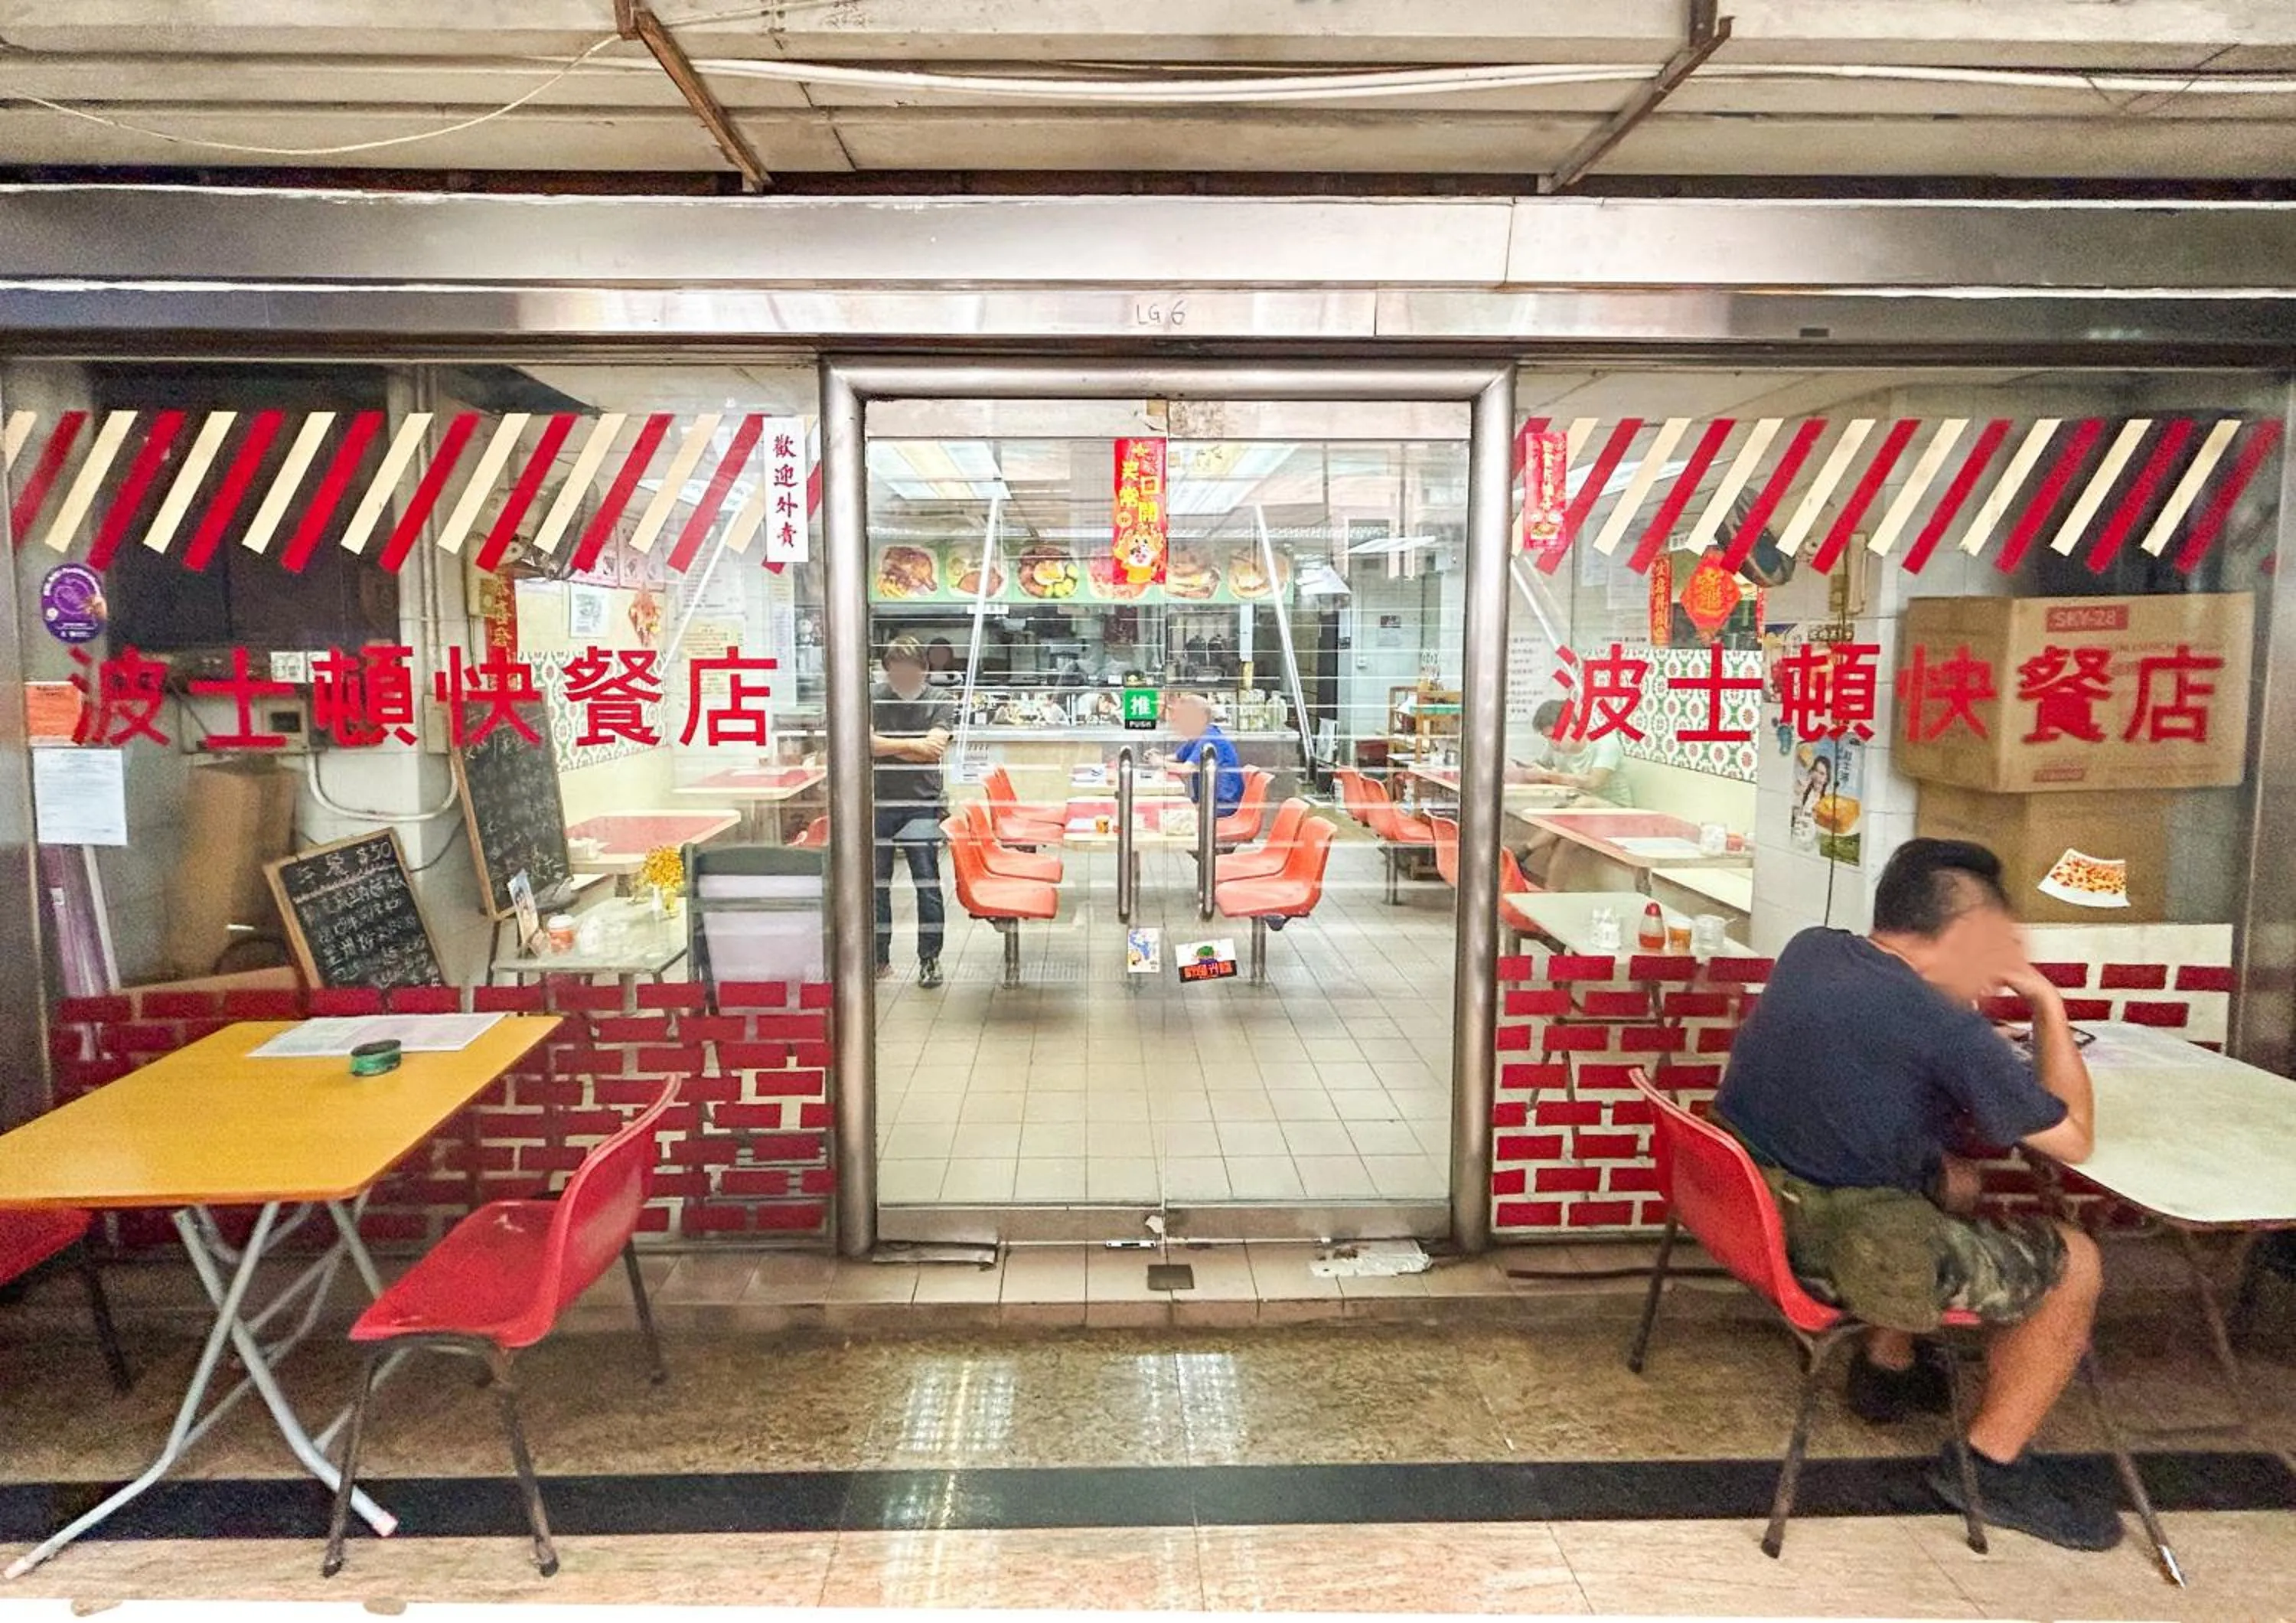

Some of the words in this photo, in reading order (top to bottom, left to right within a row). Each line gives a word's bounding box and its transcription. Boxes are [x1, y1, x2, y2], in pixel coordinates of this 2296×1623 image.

[1137, 303, 1160, 325] LG
[1170, 299, 1186, 325] 6
[2054, 609, 2117, 628] SKY-28
[67, 645, 777, 748] 波士頓快餐店
[1130, 695, 1151, 716] 推
[1552, 642, 2226, 743] 波士頓快餐店
